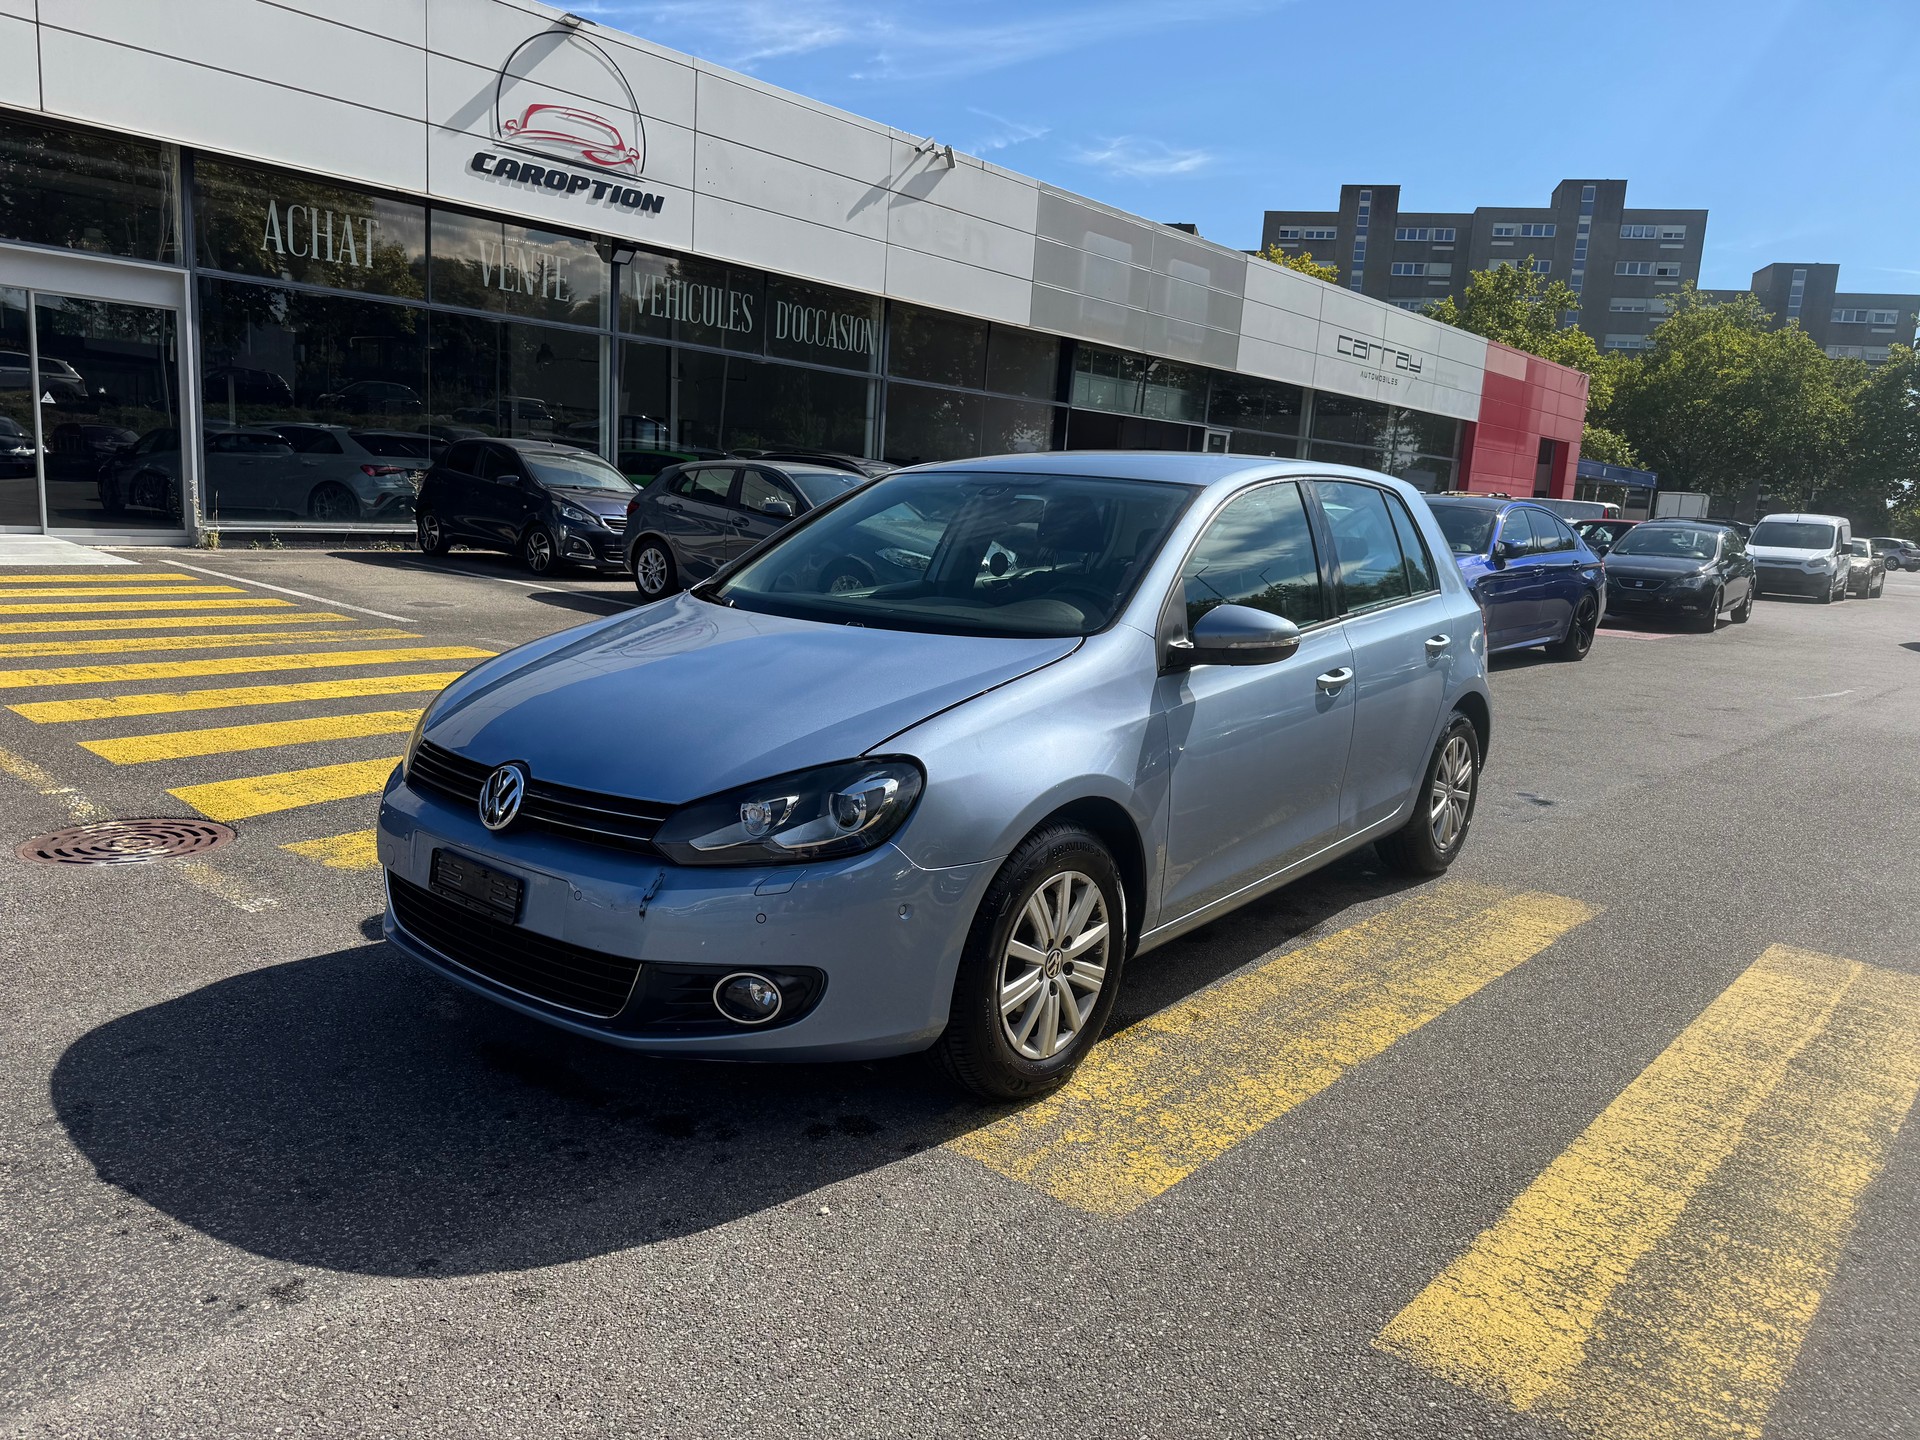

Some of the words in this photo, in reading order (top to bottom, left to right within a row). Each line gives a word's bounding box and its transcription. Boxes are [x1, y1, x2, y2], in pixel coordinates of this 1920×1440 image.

[471, 152, 665, 214] CAROPTION
[260, 199, 380, 269] ACHAT
[478, 240, 571, 302] VENTE
[634, 271, 753, 334] VEHICULES
[775, 300, 878, 355] D'OCCASION
[1360, 370, 1398, 386] AUTOMOBILES
[1052, 841, 1095, 859] BRAVURIS
